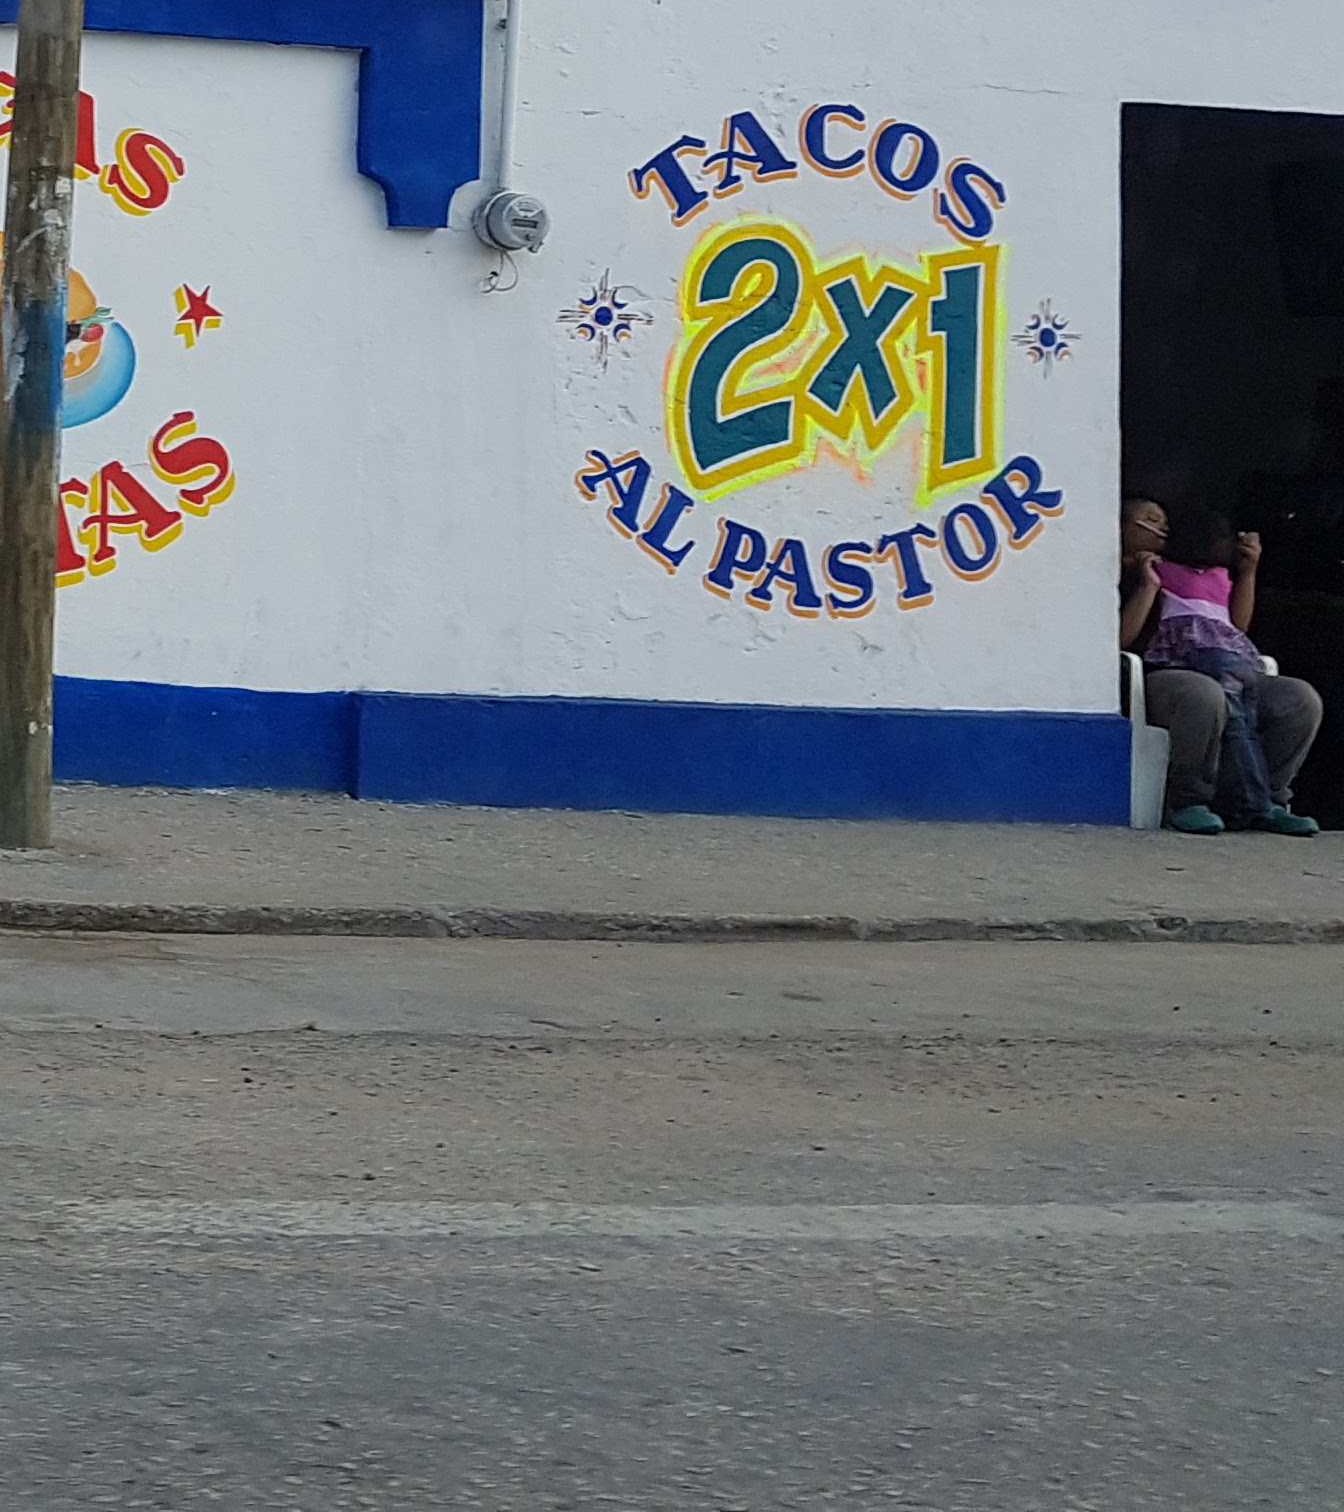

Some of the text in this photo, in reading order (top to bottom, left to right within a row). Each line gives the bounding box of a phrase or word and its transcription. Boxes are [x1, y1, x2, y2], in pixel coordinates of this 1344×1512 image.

[628, 104, 1006, 248] TACOS
[575, 450, 1064, 619] AL PASTOR
